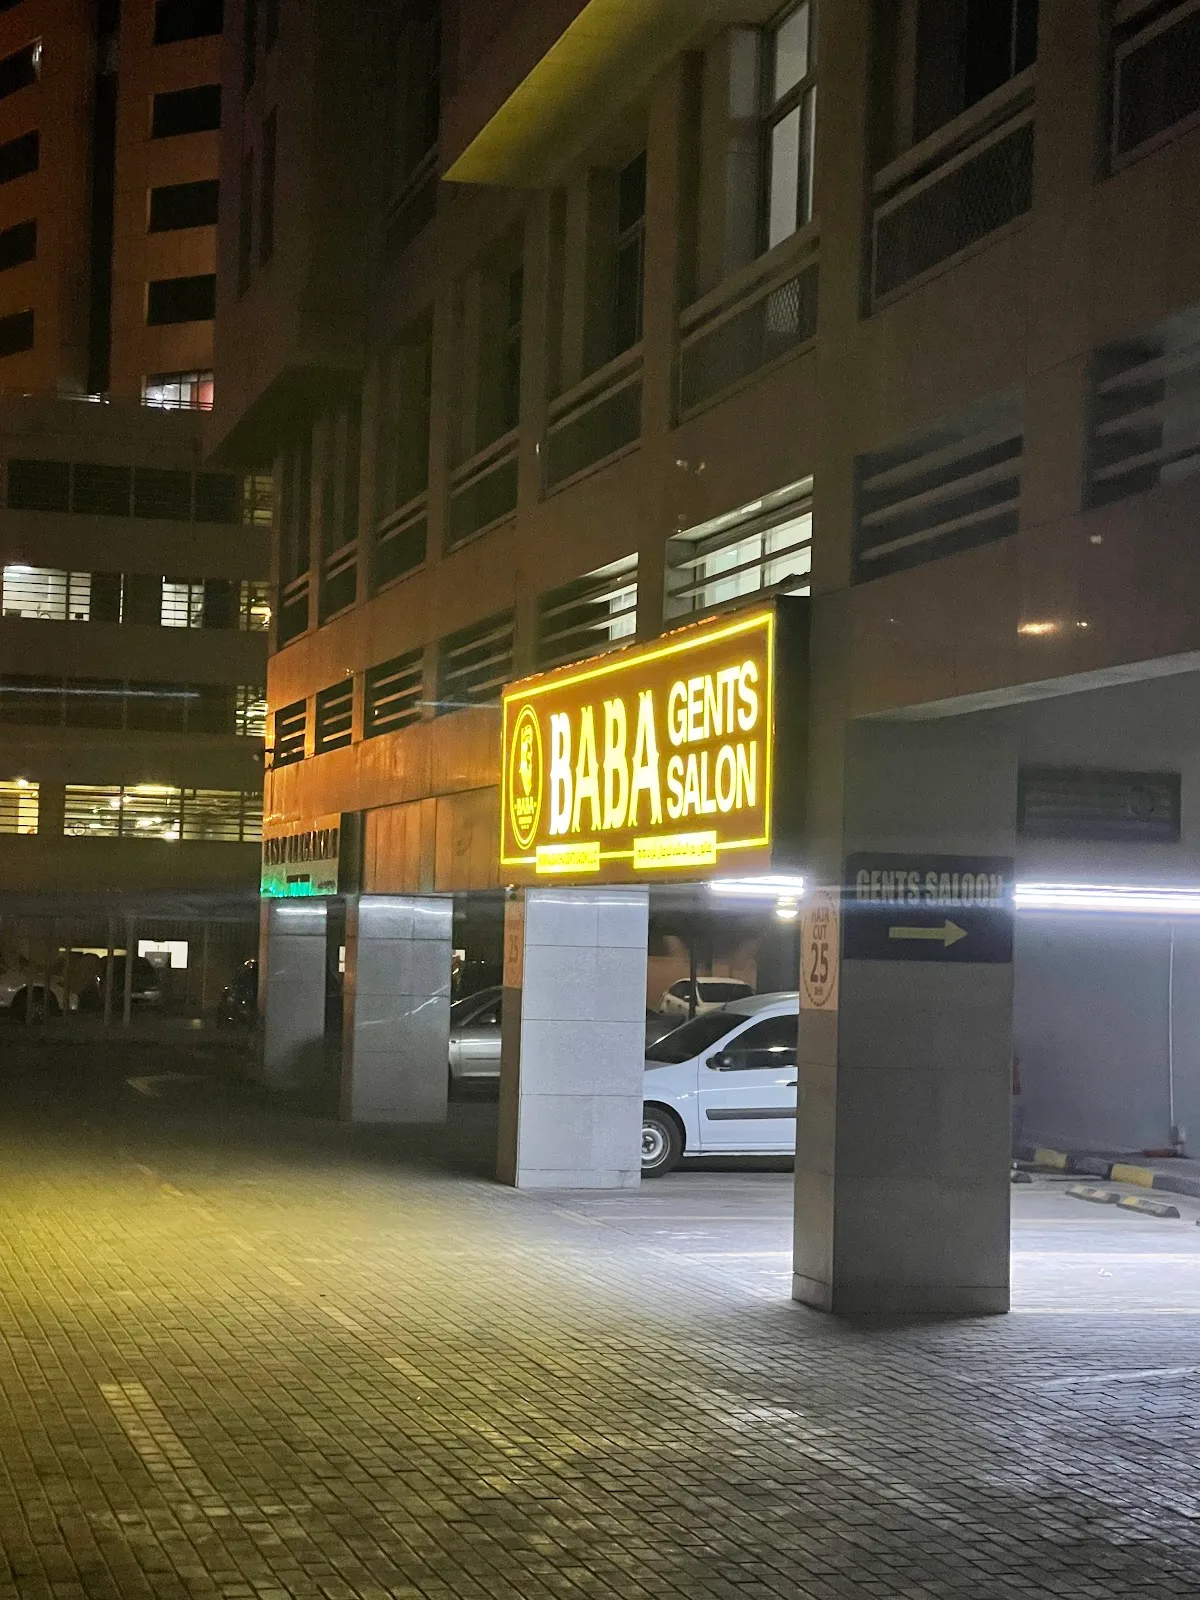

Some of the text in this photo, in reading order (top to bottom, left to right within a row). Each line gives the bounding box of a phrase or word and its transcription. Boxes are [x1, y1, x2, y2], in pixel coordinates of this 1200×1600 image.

[667, 660, 759, 746] GENTS
[549, 690, 662, 835] BABA
[666, 741, 757, 819] SALON
[857, 869, 1003, 907] GENTS SALOON
[811, 907, 830, 922] HAIR
[812, 924, 828, 940] CUT
[810, 942, 829, 983] 25
